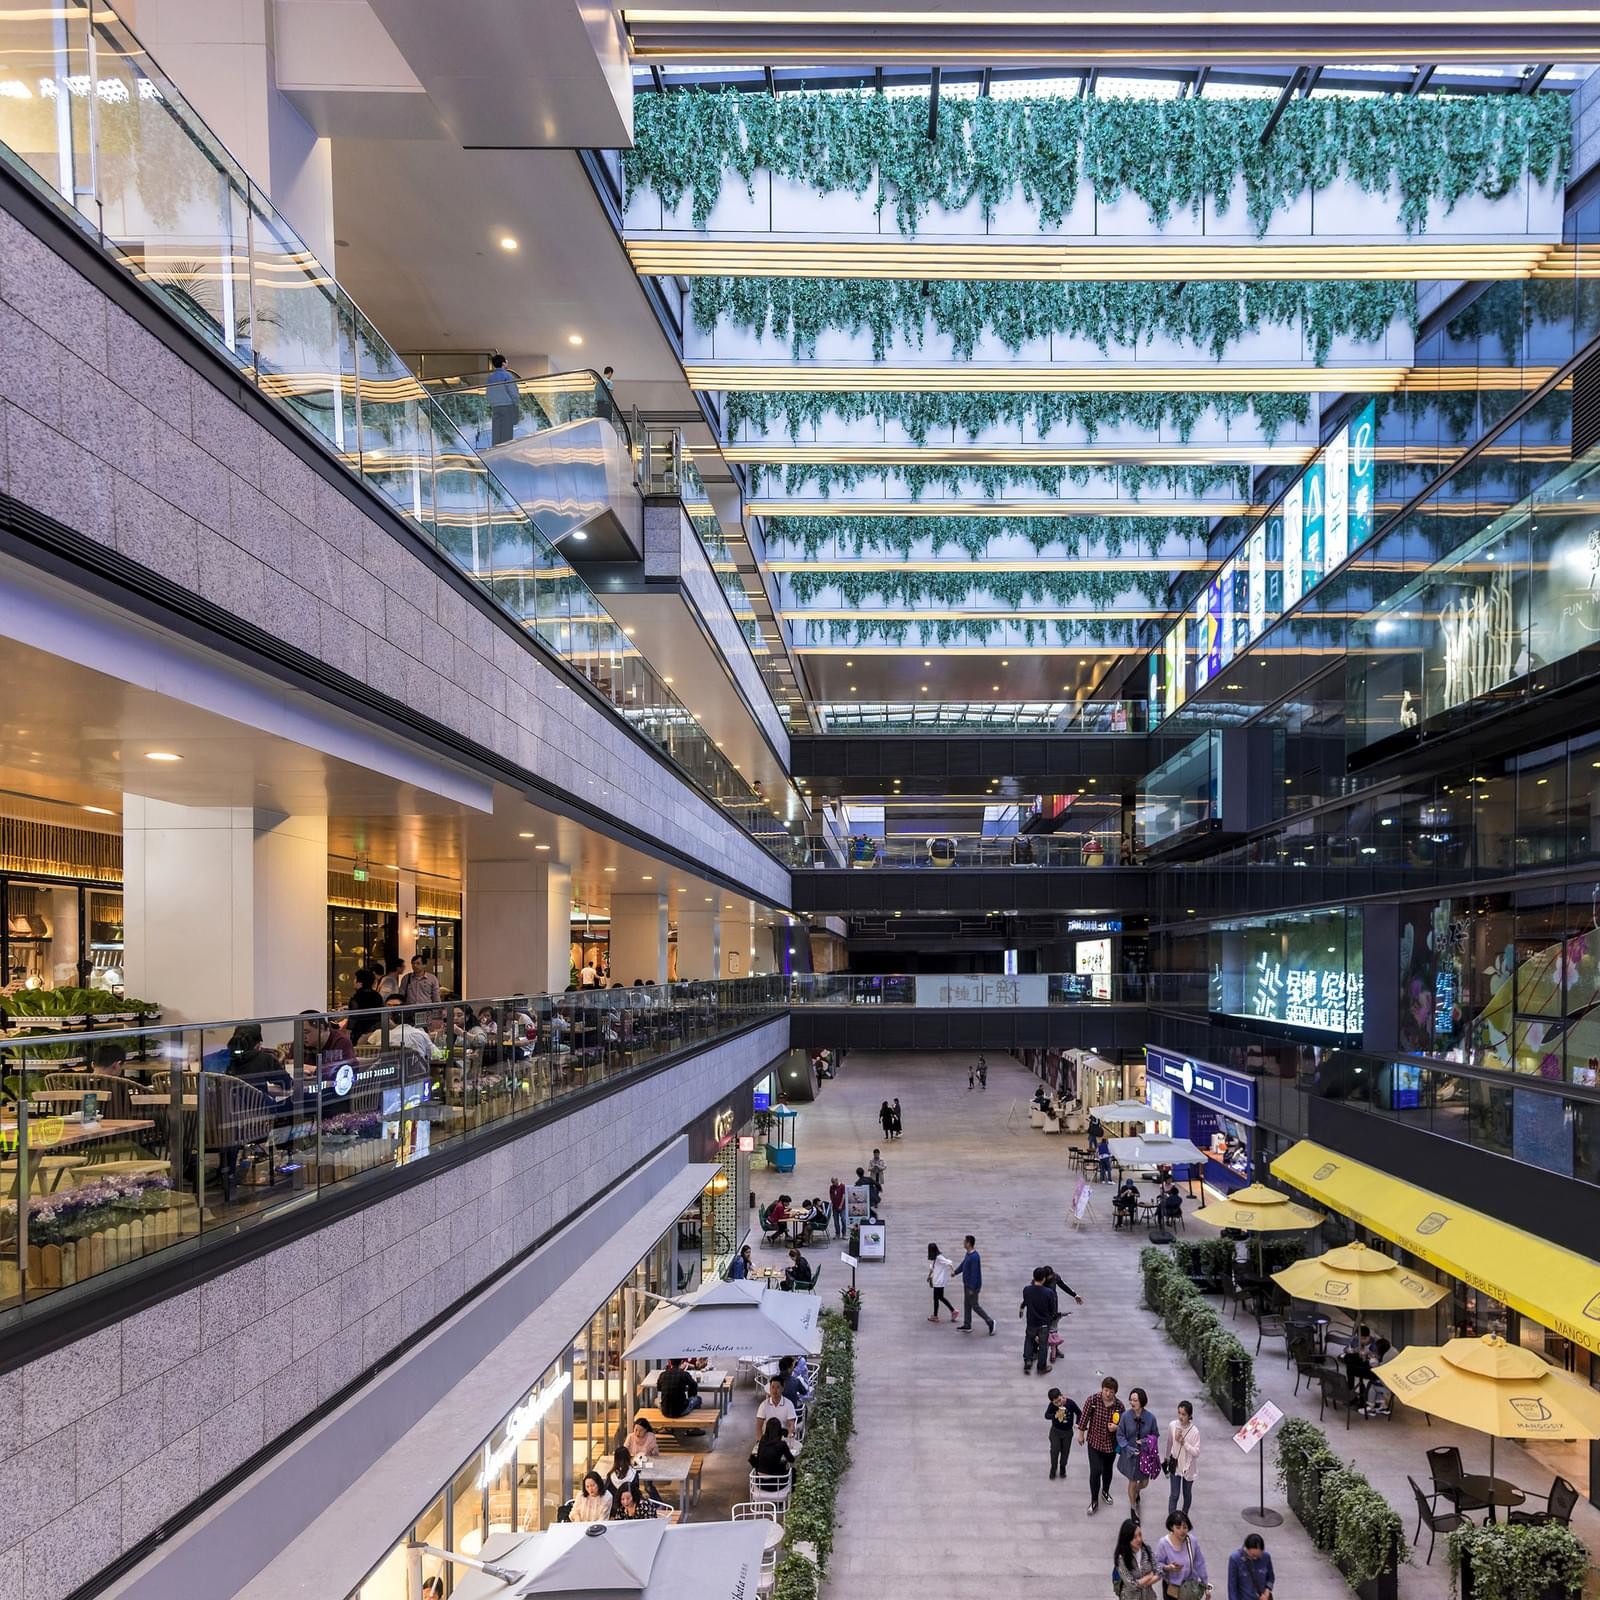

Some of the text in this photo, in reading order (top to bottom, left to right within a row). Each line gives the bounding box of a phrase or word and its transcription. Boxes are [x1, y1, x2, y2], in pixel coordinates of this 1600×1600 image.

[1464, 1271, 1508, 1304] BUBBLETEA
[697, 1343, 733, 1353] Shibata
[1554, 1319, 1592, 1348] MANGO
